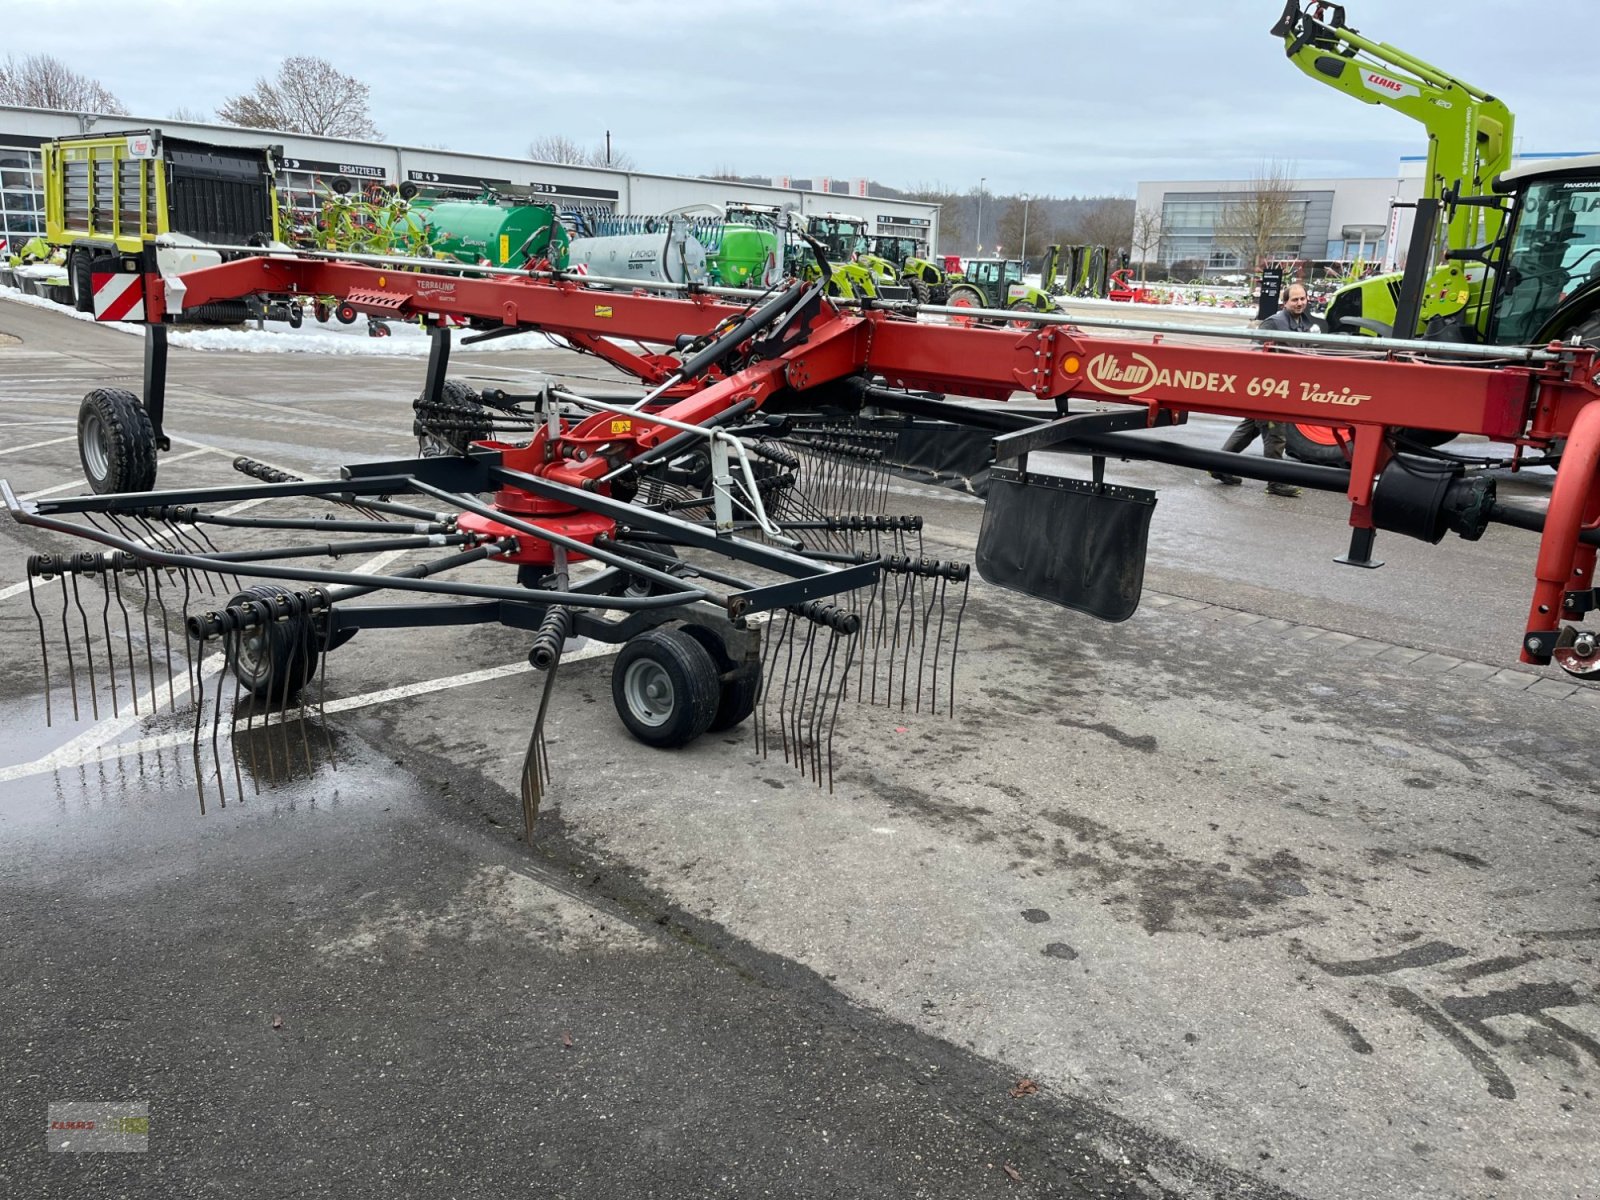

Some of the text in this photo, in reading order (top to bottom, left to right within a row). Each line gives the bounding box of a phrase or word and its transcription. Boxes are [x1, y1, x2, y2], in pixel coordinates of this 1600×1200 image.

[1368, 74, 1402, 92] CLAAS
[339, 164, 383, 177] ERSATZTEILE
[411, 171, 423, 180] TOR
[1563, 181, 1600, 189] PANORAM
[416, 279, 456, 292] TERRALINK
[1155, 368, 1238, 394] ANDEX
[1246, 376, 1290, 399] 694
[1299, 381, 1372, 406] Vario
